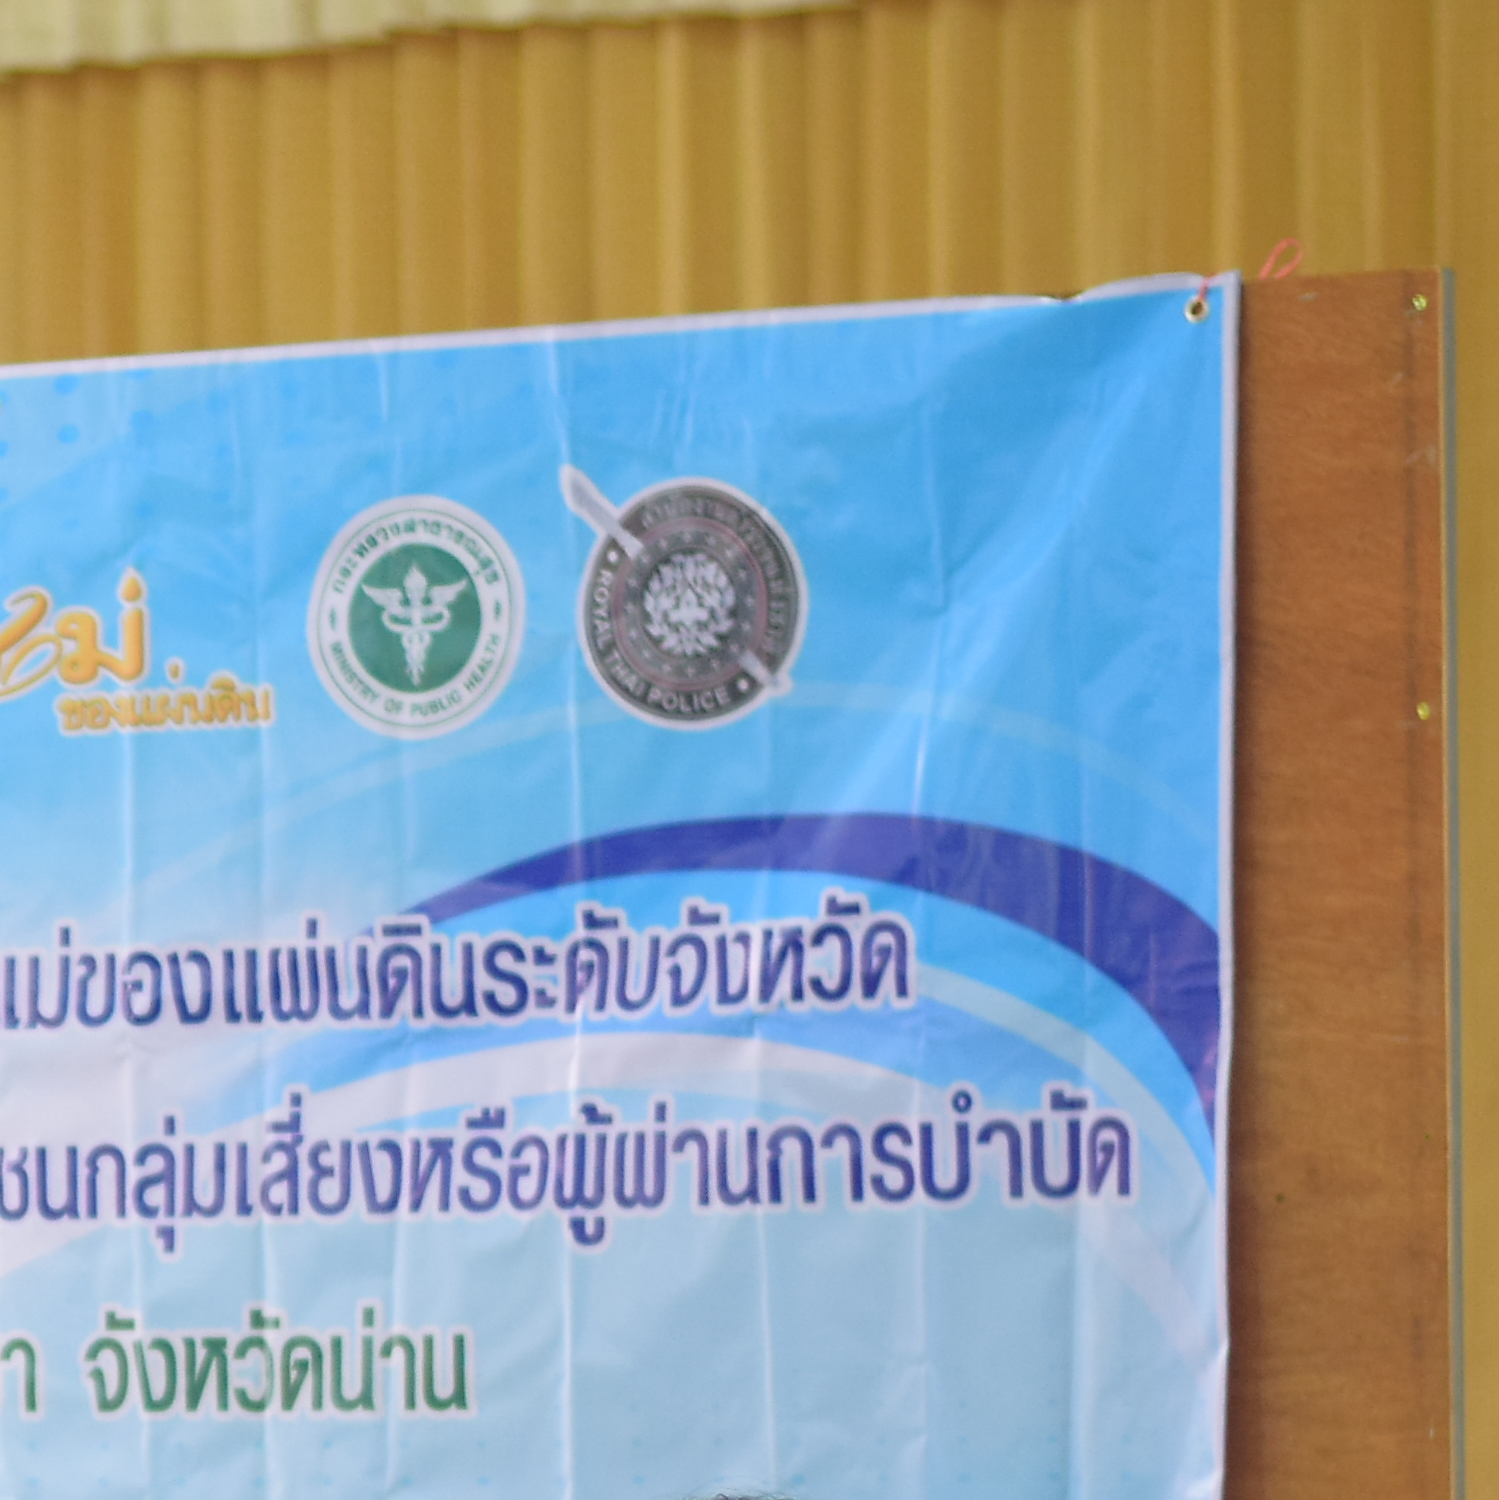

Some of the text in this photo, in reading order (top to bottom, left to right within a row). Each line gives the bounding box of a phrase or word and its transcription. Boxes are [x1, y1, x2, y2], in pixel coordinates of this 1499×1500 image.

[331, 634, 501, 717] MINISTRY OF PUBLIC HEALTH
[594, 569, 731, 712] ROYAL THAI POLICE
[57, 663, 271, 731] ของแผ่นดิน
[87, 1308, 467, 1414] จังหวัดน่าน
